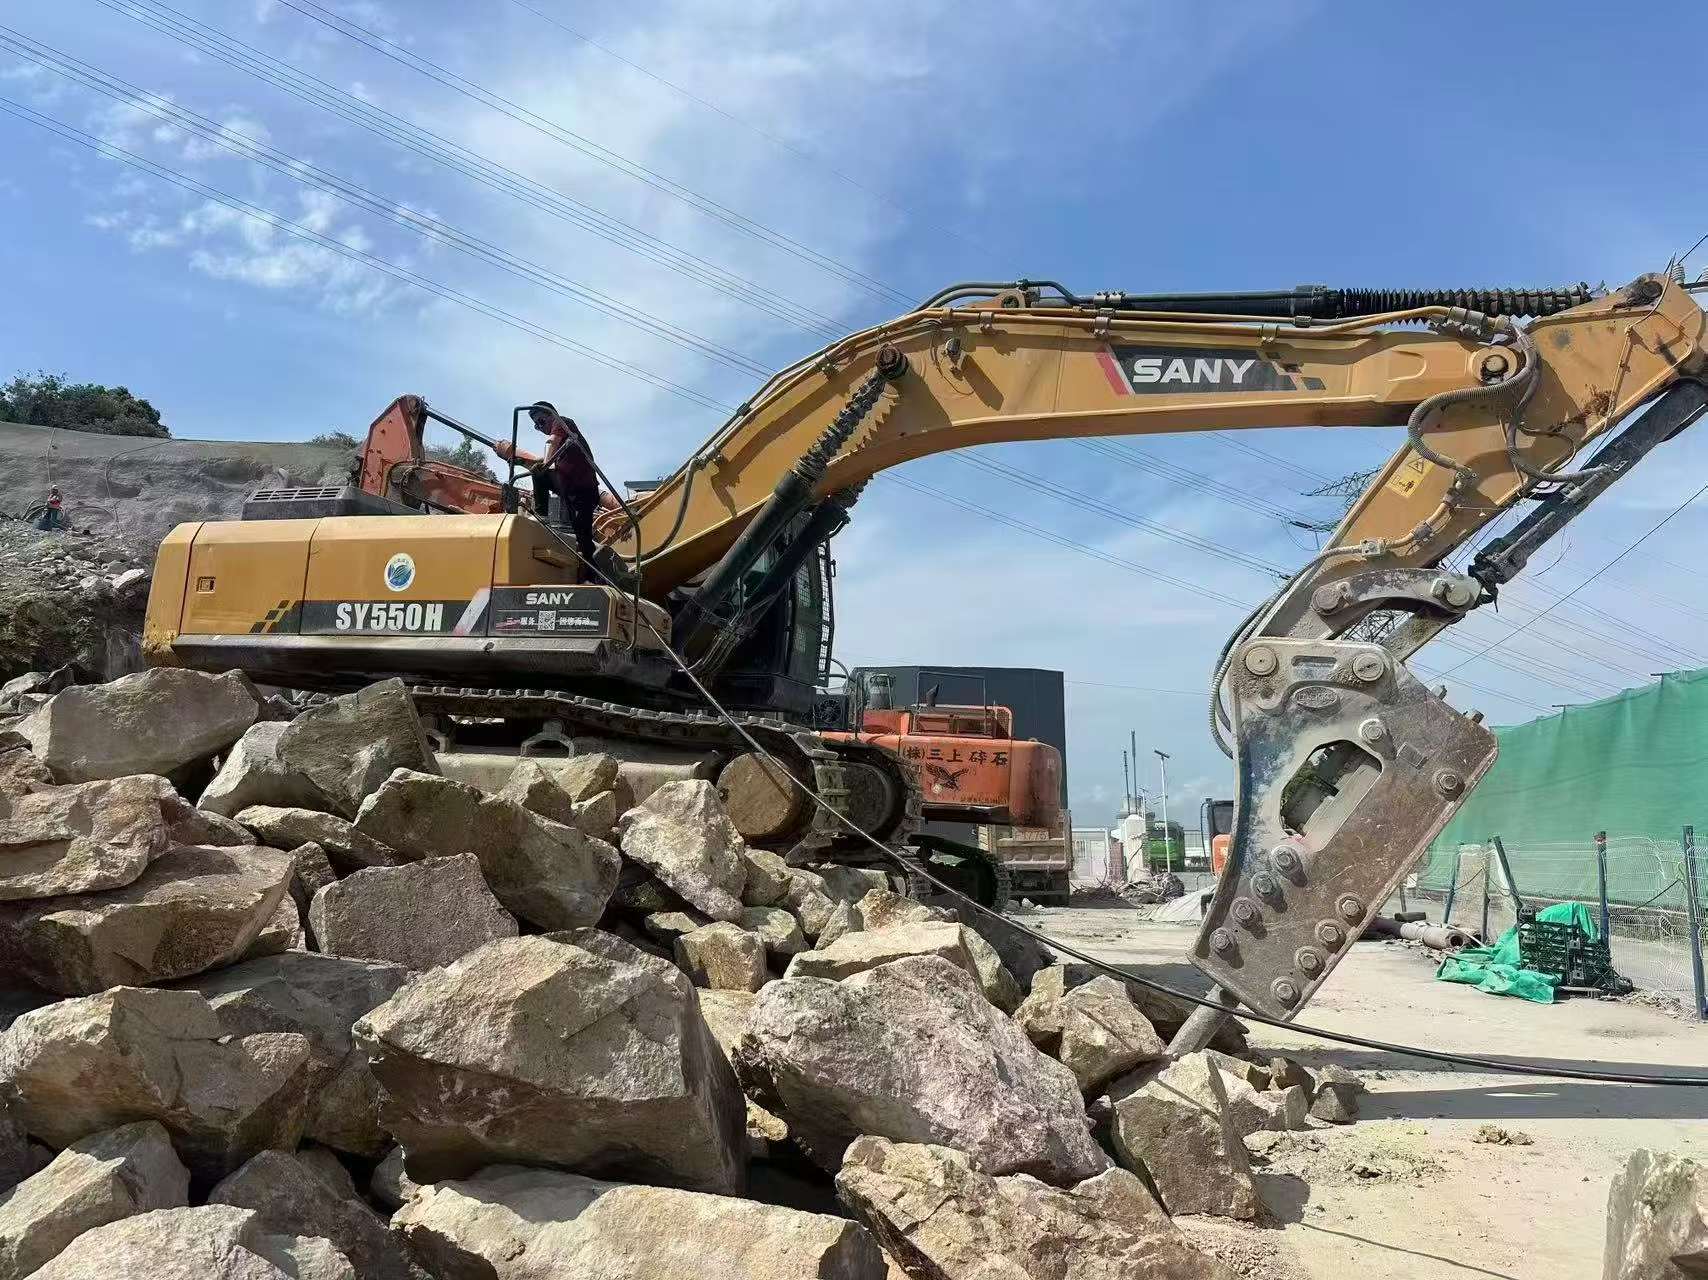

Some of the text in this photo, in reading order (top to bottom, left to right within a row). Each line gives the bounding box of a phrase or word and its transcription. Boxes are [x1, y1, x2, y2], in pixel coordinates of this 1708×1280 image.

[1133, 358, 1256, 384] SANY
[525, 592, 574, 605] SANY
[335, 602, 444, 631] SY550H
